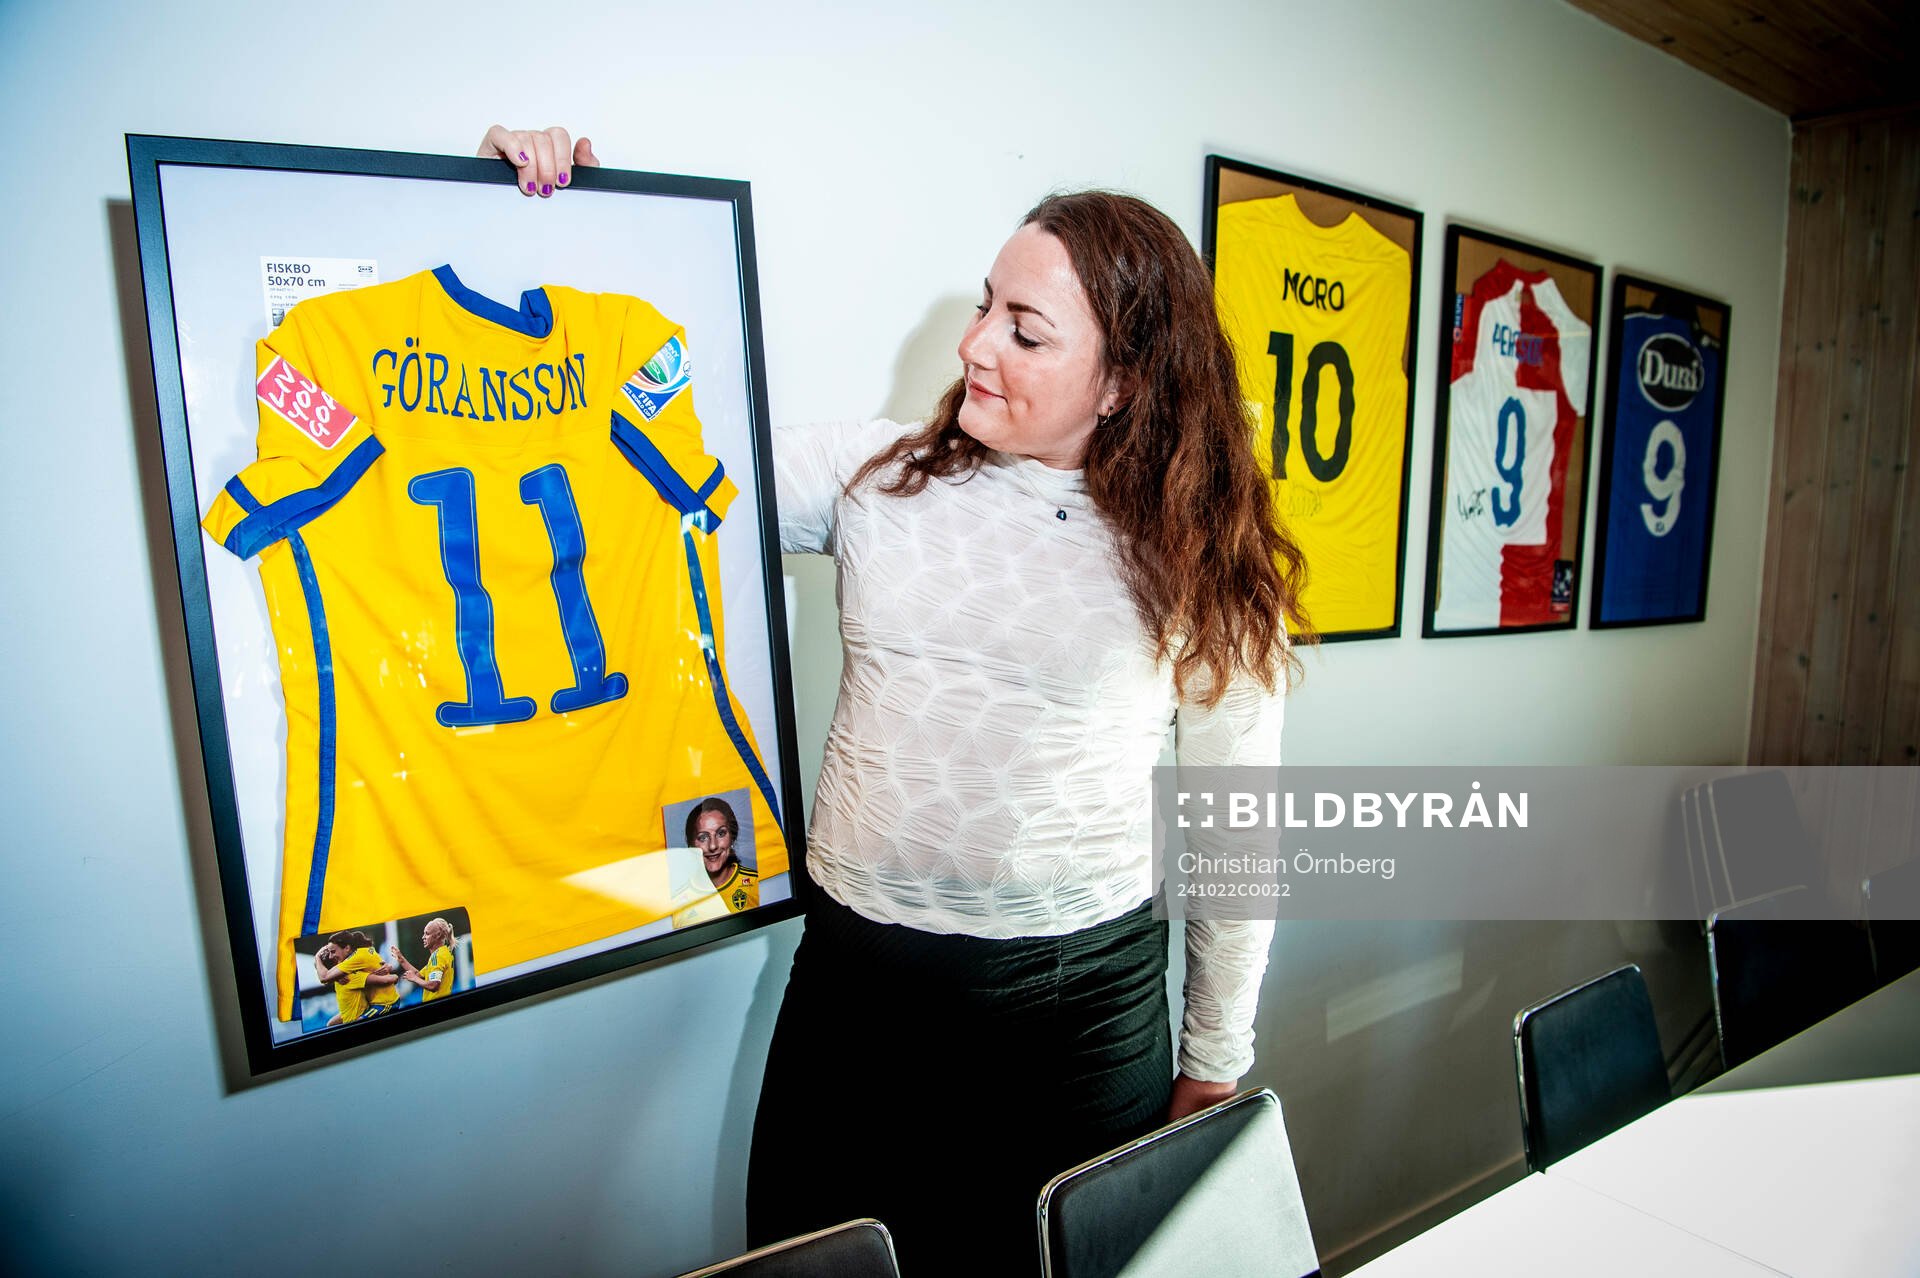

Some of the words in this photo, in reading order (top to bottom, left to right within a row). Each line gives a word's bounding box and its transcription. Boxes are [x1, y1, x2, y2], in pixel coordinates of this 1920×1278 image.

[266, 263, 311, 274] FISKBO
[268, 276, 304, 287] 50x70
[307, 278, 326, 287] cm
[1282, 268, 1344, 312] MORO
[372, 336, 588, 422] GÖRANSSON
[631, 393, 645, 409] WORLD
[638, 391, 657, 415] FIFA
[1267, 331, 1355, 483] 10
[1491, 396, 1526, 528] 9
[1640, 420, 1687, 537] 9
[407, 463, 629, 728] 11
